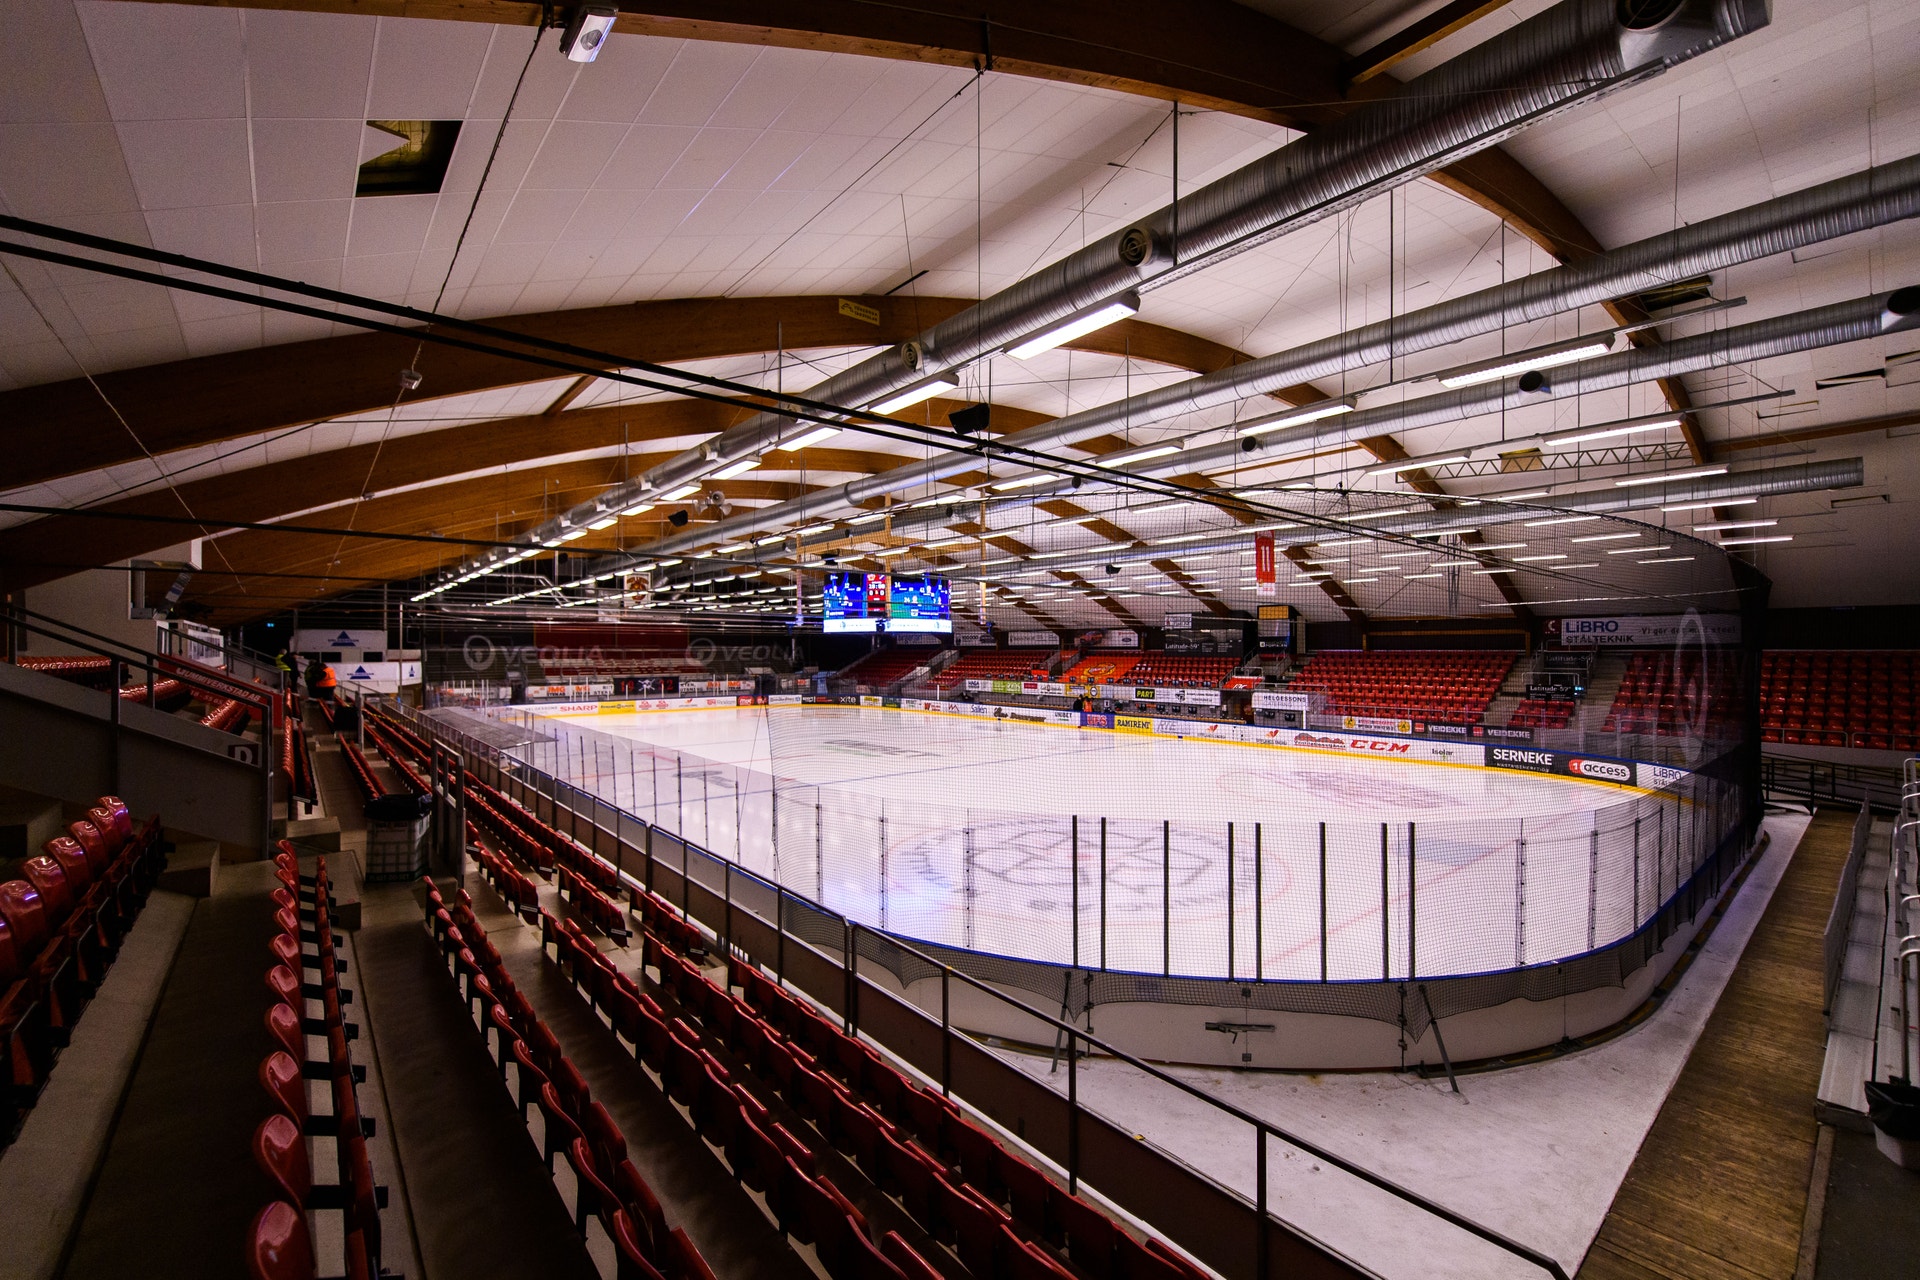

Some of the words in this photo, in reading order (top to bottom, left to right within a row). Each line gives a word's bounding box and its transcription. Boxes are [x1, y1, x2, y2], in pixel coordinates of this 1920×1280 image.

[1261, 546, 1270, 572] 11
[1136, 691, 1154, 699] PART
[1116, 719, 1150, 729] RAMIRENT
[1428, 725, 1467, 734] VEIDEKKE
[1488, 729, 1531, 739] VEIDEKKE
[1350, 740, 1411, 753] CCM
[234, 746, 254, 764] D
[1493, 749, 1552, 766] SERNEKE
[1583, 762, 1627, 777] access
